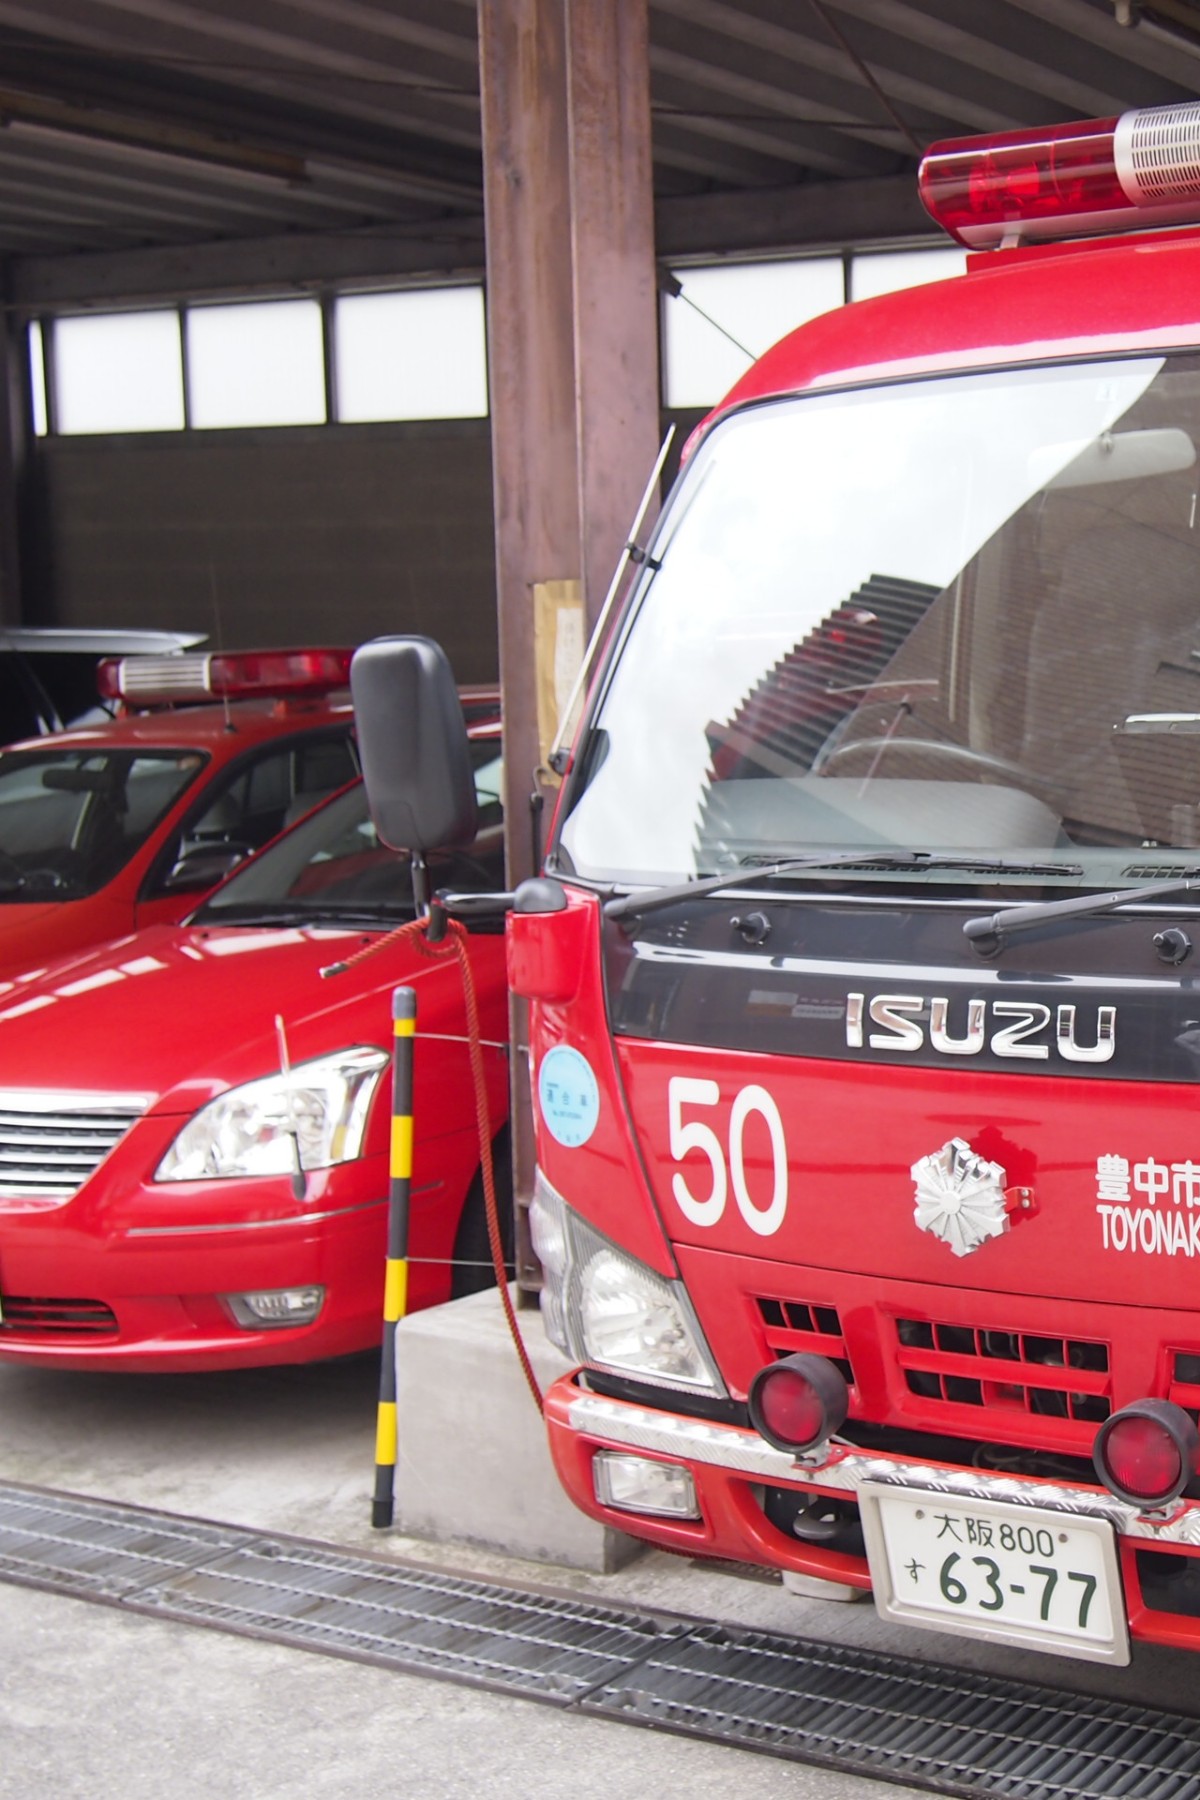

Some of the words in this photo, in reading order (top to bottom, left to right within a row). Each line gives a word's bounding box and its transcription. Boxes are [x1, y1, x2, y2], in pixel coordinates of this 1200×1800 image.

[846, 992, 1117, 1062] ISUZU
[668, 1076, 788, 1236] 50
[940, 1552, 1097, 1628] 63-77
